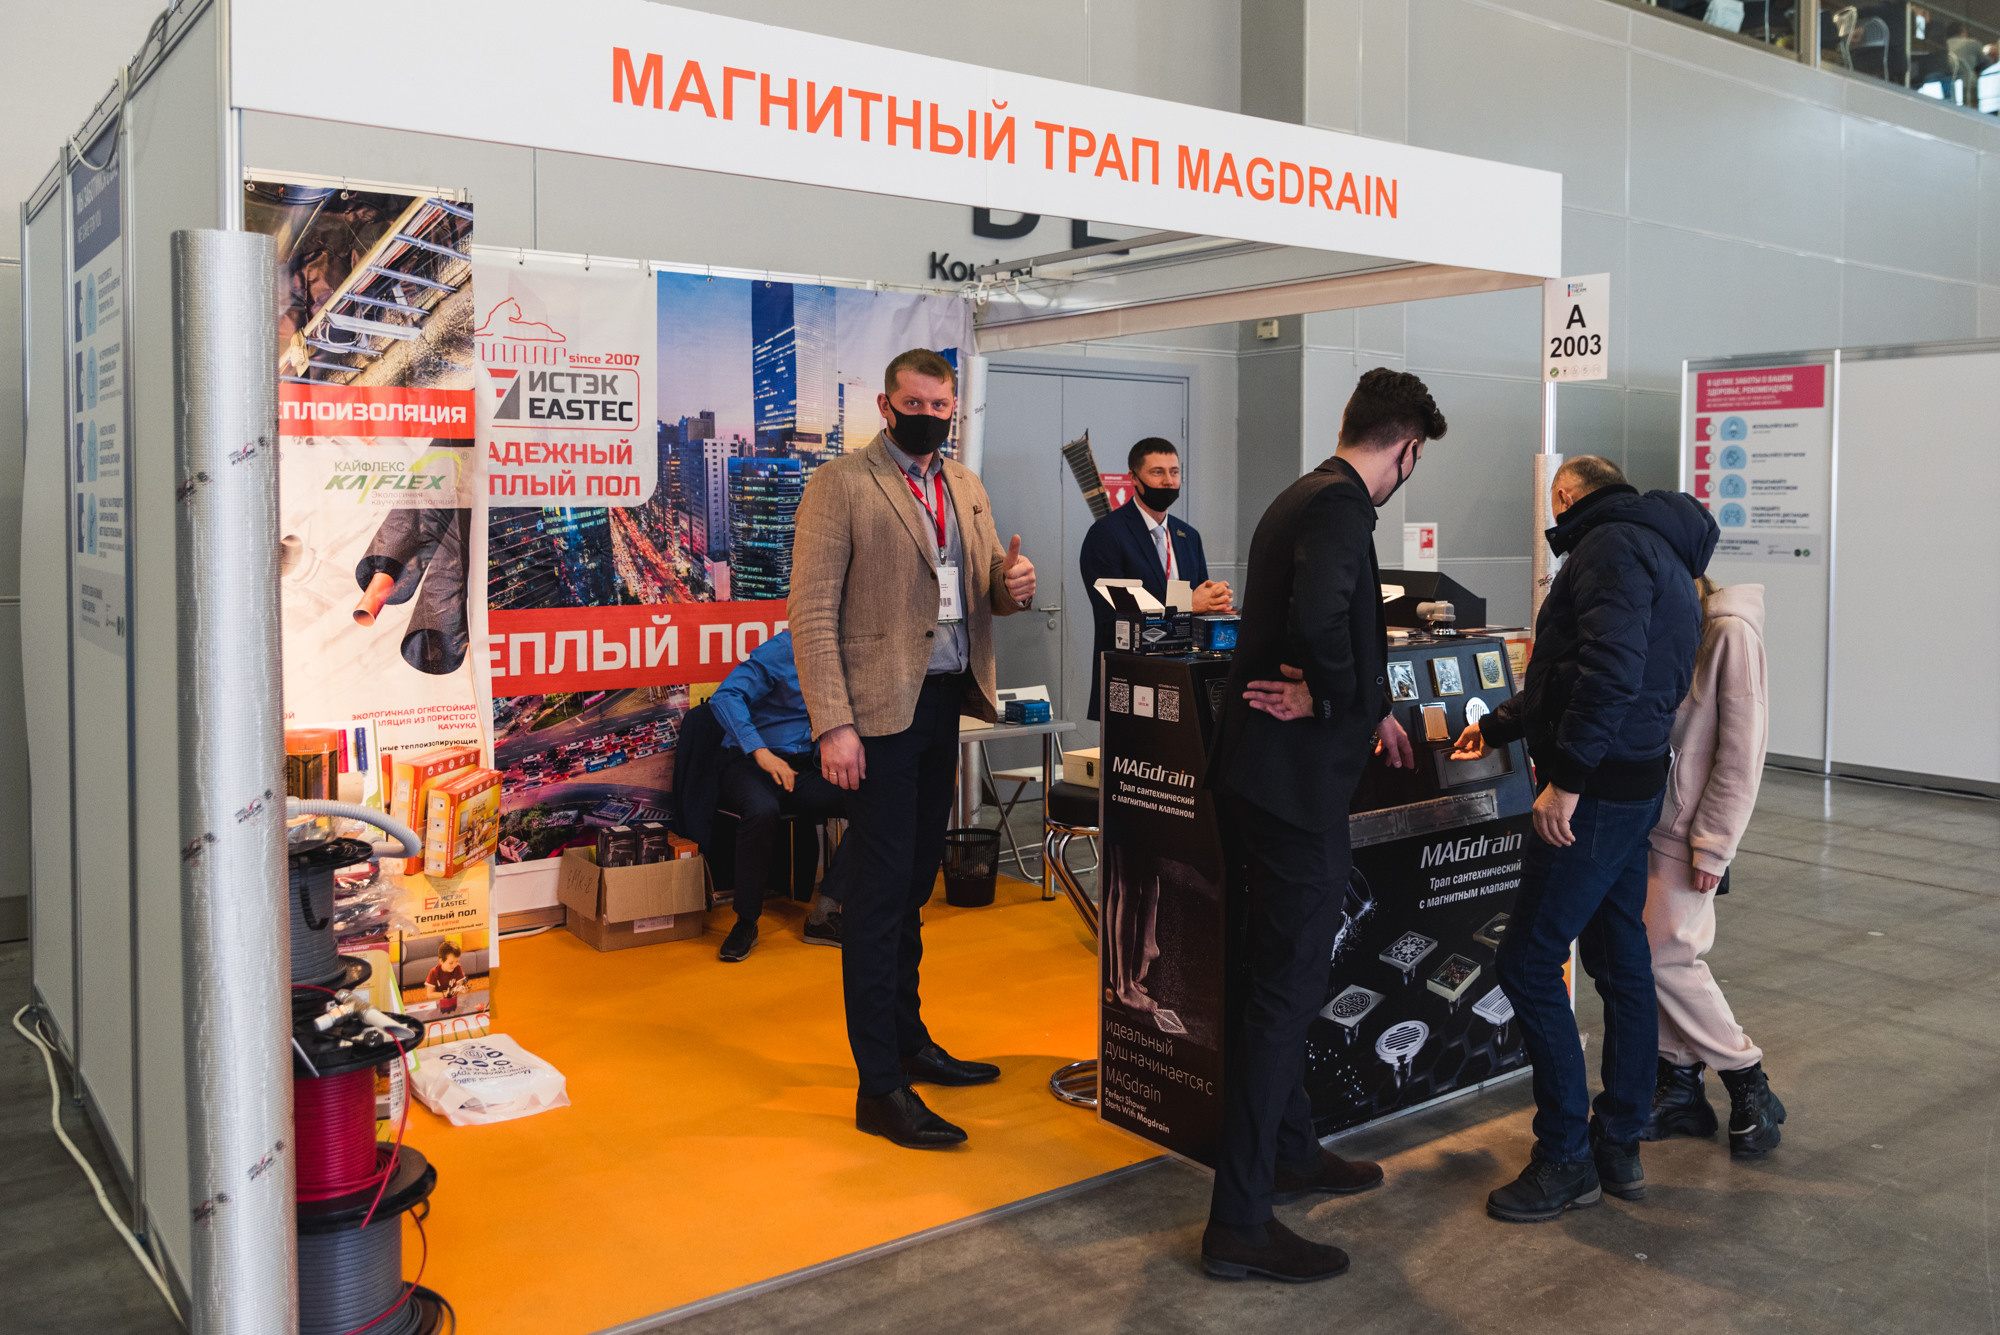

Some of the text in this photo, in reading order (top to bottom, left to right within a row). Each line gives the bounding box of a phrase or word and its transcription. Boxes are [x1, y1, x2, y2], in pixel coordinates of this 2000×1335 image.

[613, 46, 1398, 219] МАГНИТНЫЙ ТРАП MAGDRAIN
[1566, 304, 1586, 330] A
[1550, 334, 1602, 358] 2003
[569, 353, 640, 366] since 2007
[529, 370, 618, 396] ИСТЭК
[529, 398, 633, 422] EASTEC
[334, 460, 405, 472] КАЙФЛЕКС
[586, 476, 640, 496] ПОЛ
[700, 620, 789, 665] ПО
[352, 703, 476, 720] ЭКОЛОГИЧНАЯ ОГНЕСТОЙКАЯ
[414, 716, 426, 724] ИЗ
[427, 713, 476, 723] ПОРИСТОГО
[438, 722, 477, 731] КАУЧУКА
[1112, 756, 1196, 788] MAGdrain
[1112, 793, 1195, 819] с магнитным клапаном
[1120, 781, 1195, 806] Трап сантехнический
[1420, 830, 1522, 869] MAGdrain
[1430, 859, 1522, 891] Трап сантехнический
[441, 899, 467, 908] EASTEC
[1419, 878, 1521, 909] с магнитным клапаном
[415, 909, 477, 923] Теплый пол
[1106, 1020, 1173, 1056] идеальный
[1105, 1041, 1213, 1095] душ начинается с
[1106, 1066, 1160, 1103] MAGdrain
[1105, 1087, 1147, 1112] Perfect Shower
[1105, 1098, 1170, 1133] Starts With Magdrain
